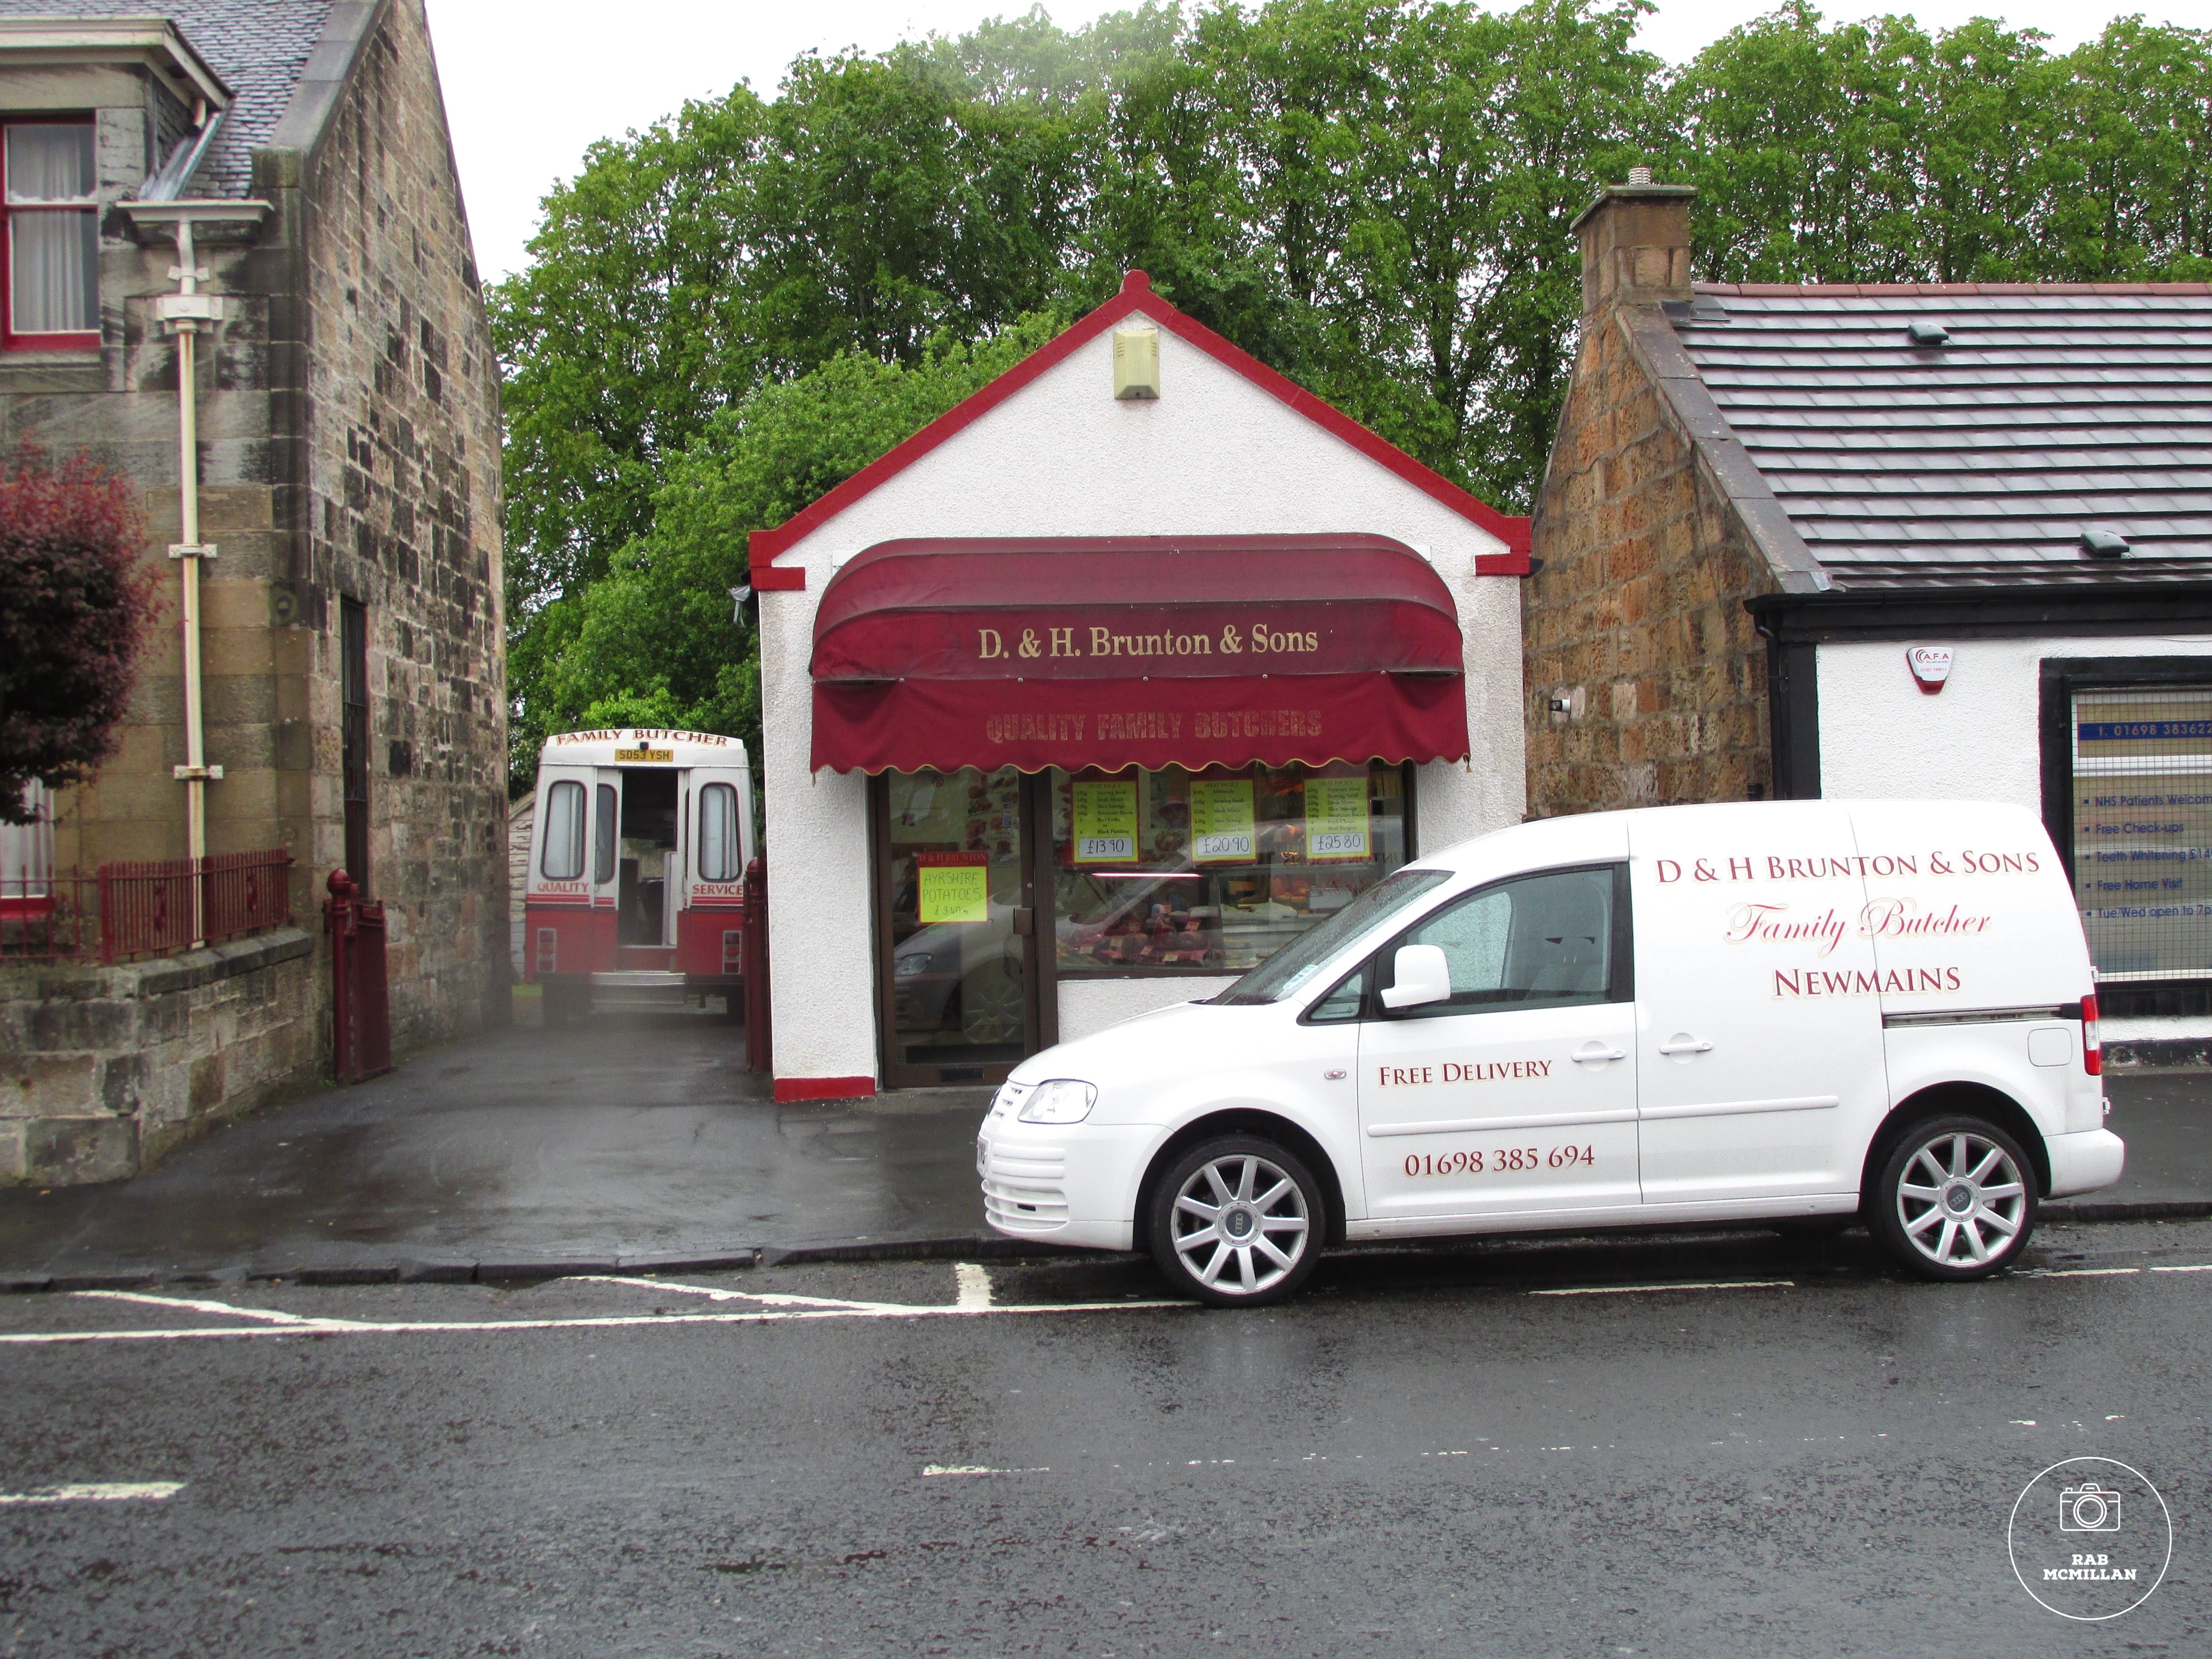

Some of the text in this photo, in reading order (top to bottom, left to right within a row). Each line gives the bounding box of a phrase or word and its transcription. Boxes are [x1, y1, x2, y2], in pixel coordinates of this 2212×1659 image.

[978, 624, 1318, 659] D. & H. Brunton & Sons
[986, 710, 1322, 744] QUALITY FAMILY BUTCHERS
[2114, 724, 2157, 736] 01698
[2164, 723, 2212, 734] 383622
[556, 729, 727, 747] FAMILY BUTCHER
[620, 750, 669, 759] SD53 YSH
[2095, 795, 2117, 806] NHS
[2120, 795, 2164, 805] Patients
[2096, 822, 2184, 834] Free Check-ups
[2097, 851, 2127, 862] Teeth
[2131, 850, 2186, 862] Whitening
[1655, 850, 2040, 884] D & H BRUNTON & SONS
[924, 872, 980, 886] AYRSHIRE
[2098, 878, 2183, 890] Free Home Visit
[538, 882, 589, 892] QUALITY
[692, 884, 743, 894] SERVICE
[922, 888, 982, 902] POTATOES
[2150, 907, 2178, 917] open
[2183, 906, 2193, 915] to
[1727, 897, 1992, 956] Family Butcher
[1775, 966, 1961, 997] NEWMAINS
[1378, 1059, 1552, 1086] FREE DELIVERY
[1404, 1144, 1595, 1177] 01698 385 694
